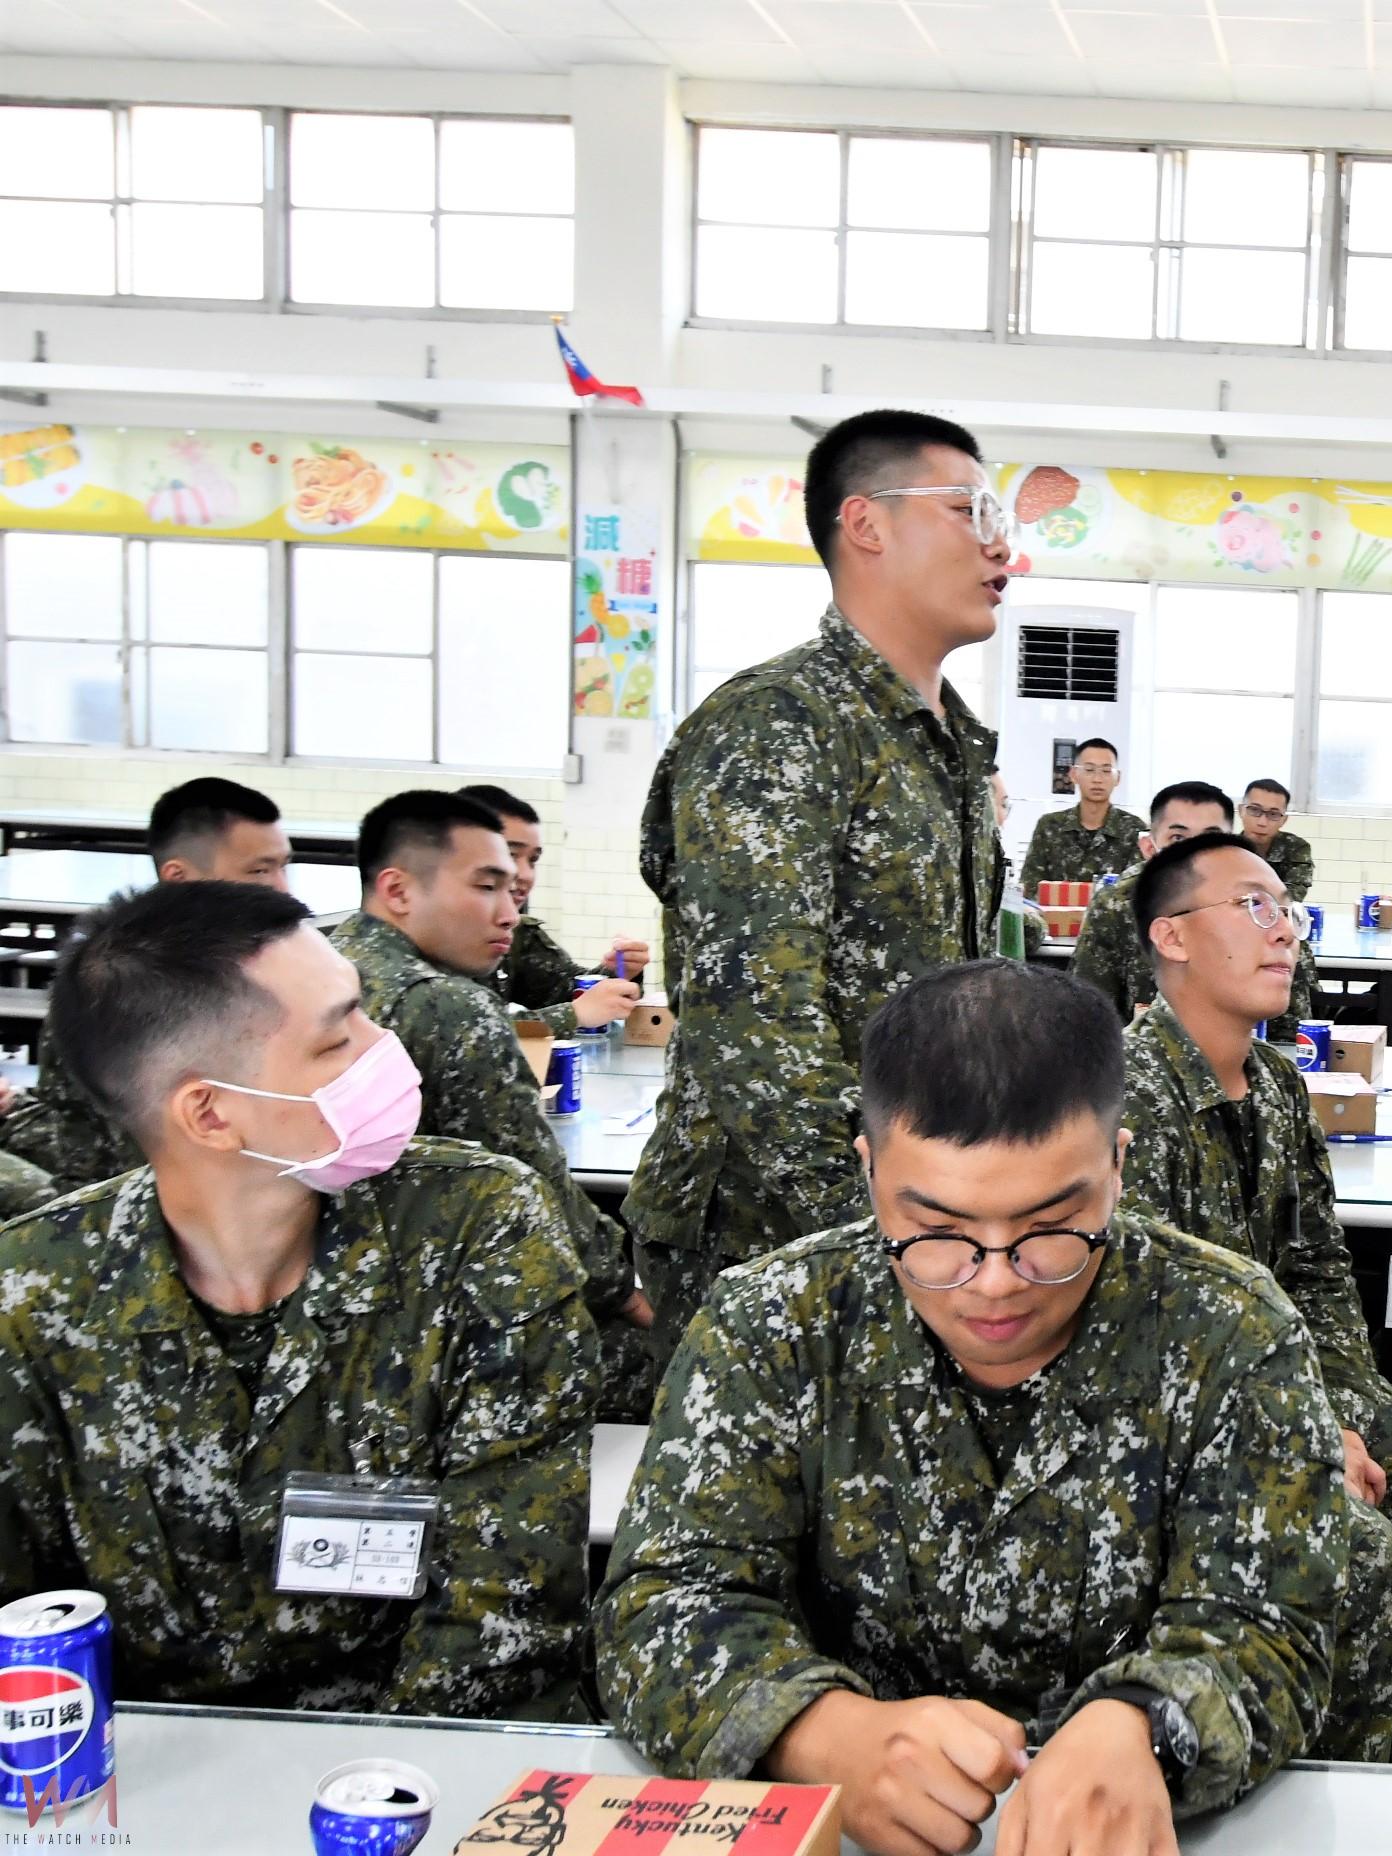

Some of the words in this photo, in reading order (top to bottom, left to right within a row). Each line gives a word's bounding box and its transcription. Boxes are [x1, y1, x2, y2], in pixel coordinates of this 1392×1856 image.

[601, 1797, 710, 1821] Chicken
[713, 1804, 788, 1825] Fried
[615, 1815, 747, 1843] Kentucky
